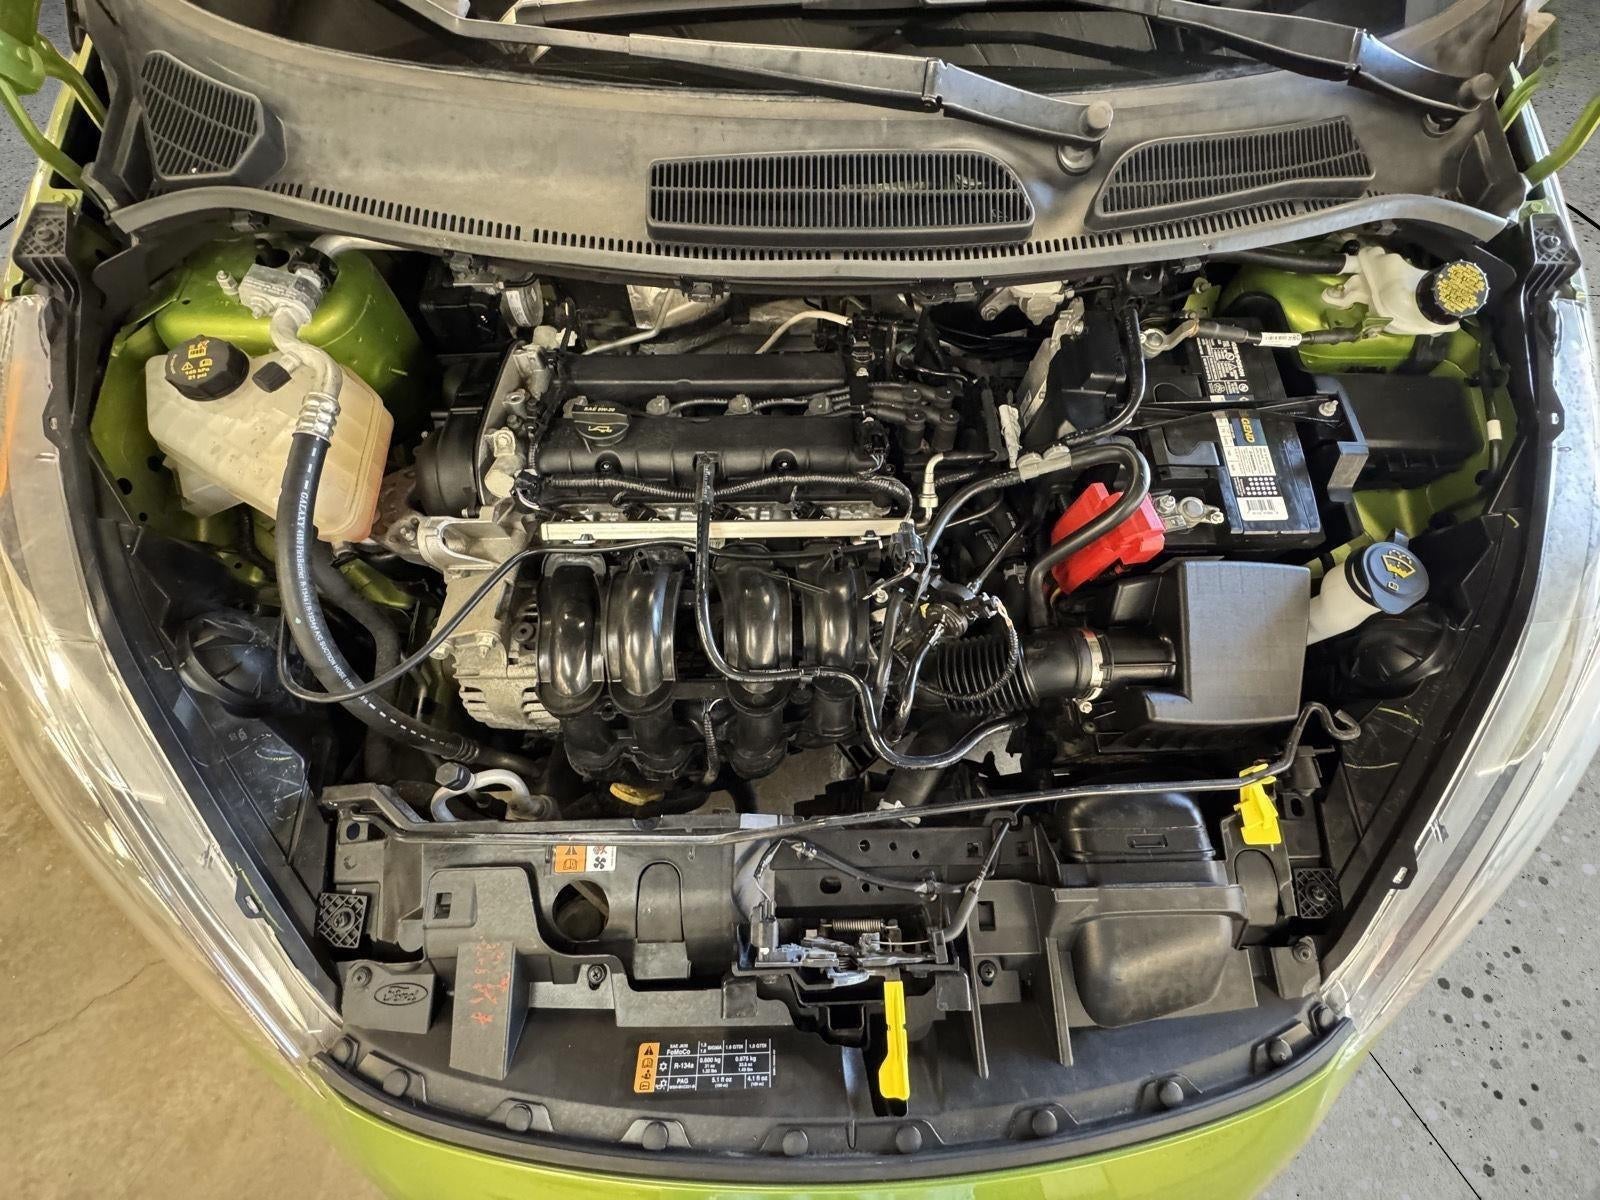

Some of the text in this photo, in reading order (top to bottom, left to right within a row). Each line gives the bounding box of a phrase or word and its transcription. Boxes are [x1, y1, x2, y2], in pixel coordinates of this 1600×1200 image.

[297, 491, 308, 529] GALAXY
[319, 640, 336, 666] SUCTION
[333, 664, 347, 680] HOSE
